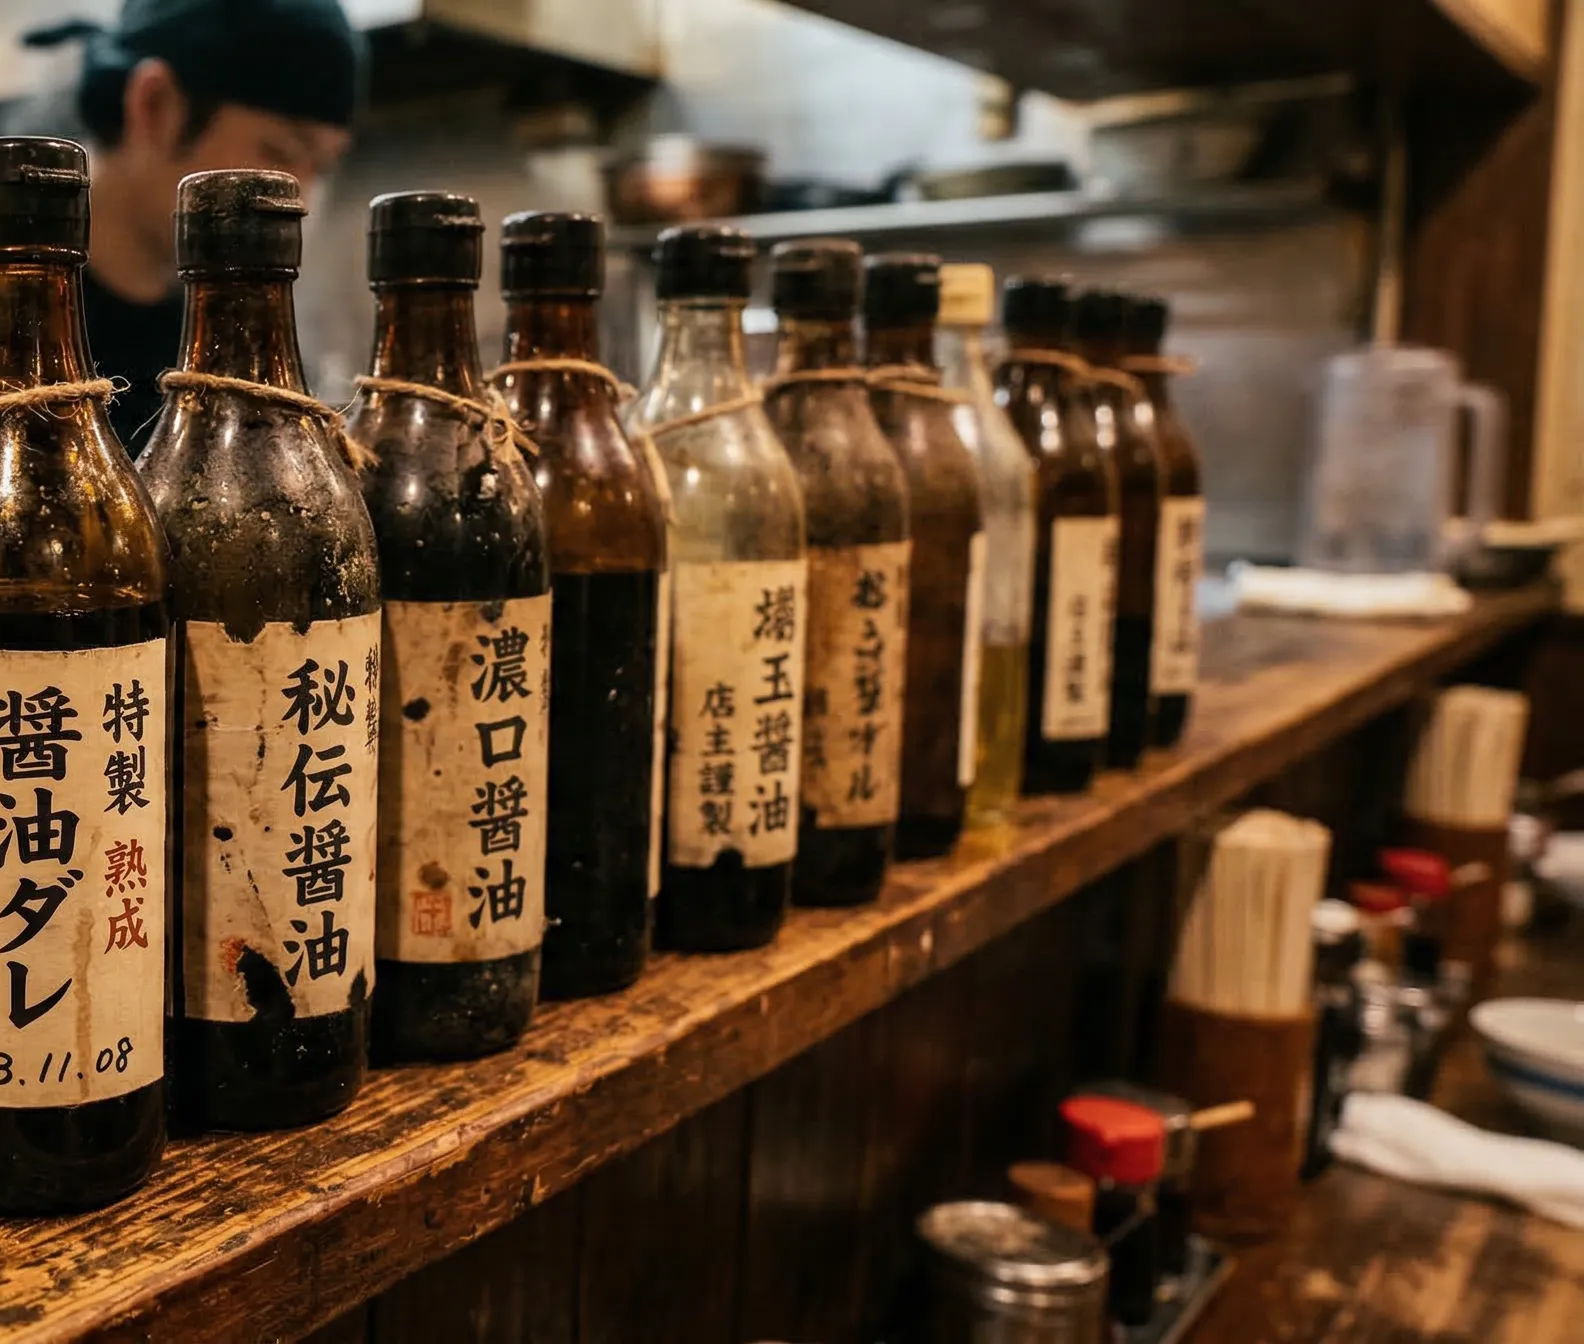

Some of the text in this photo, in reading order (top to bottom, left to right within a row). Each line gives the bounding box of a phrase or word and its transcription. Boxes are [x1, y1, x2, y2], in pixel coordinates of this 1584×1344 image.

[103, 679, 151, 956] 特製 熟成
[280, 658, 356, 987] 秘伝醤油
[466, 625, 534, 930] 濃口醤油
